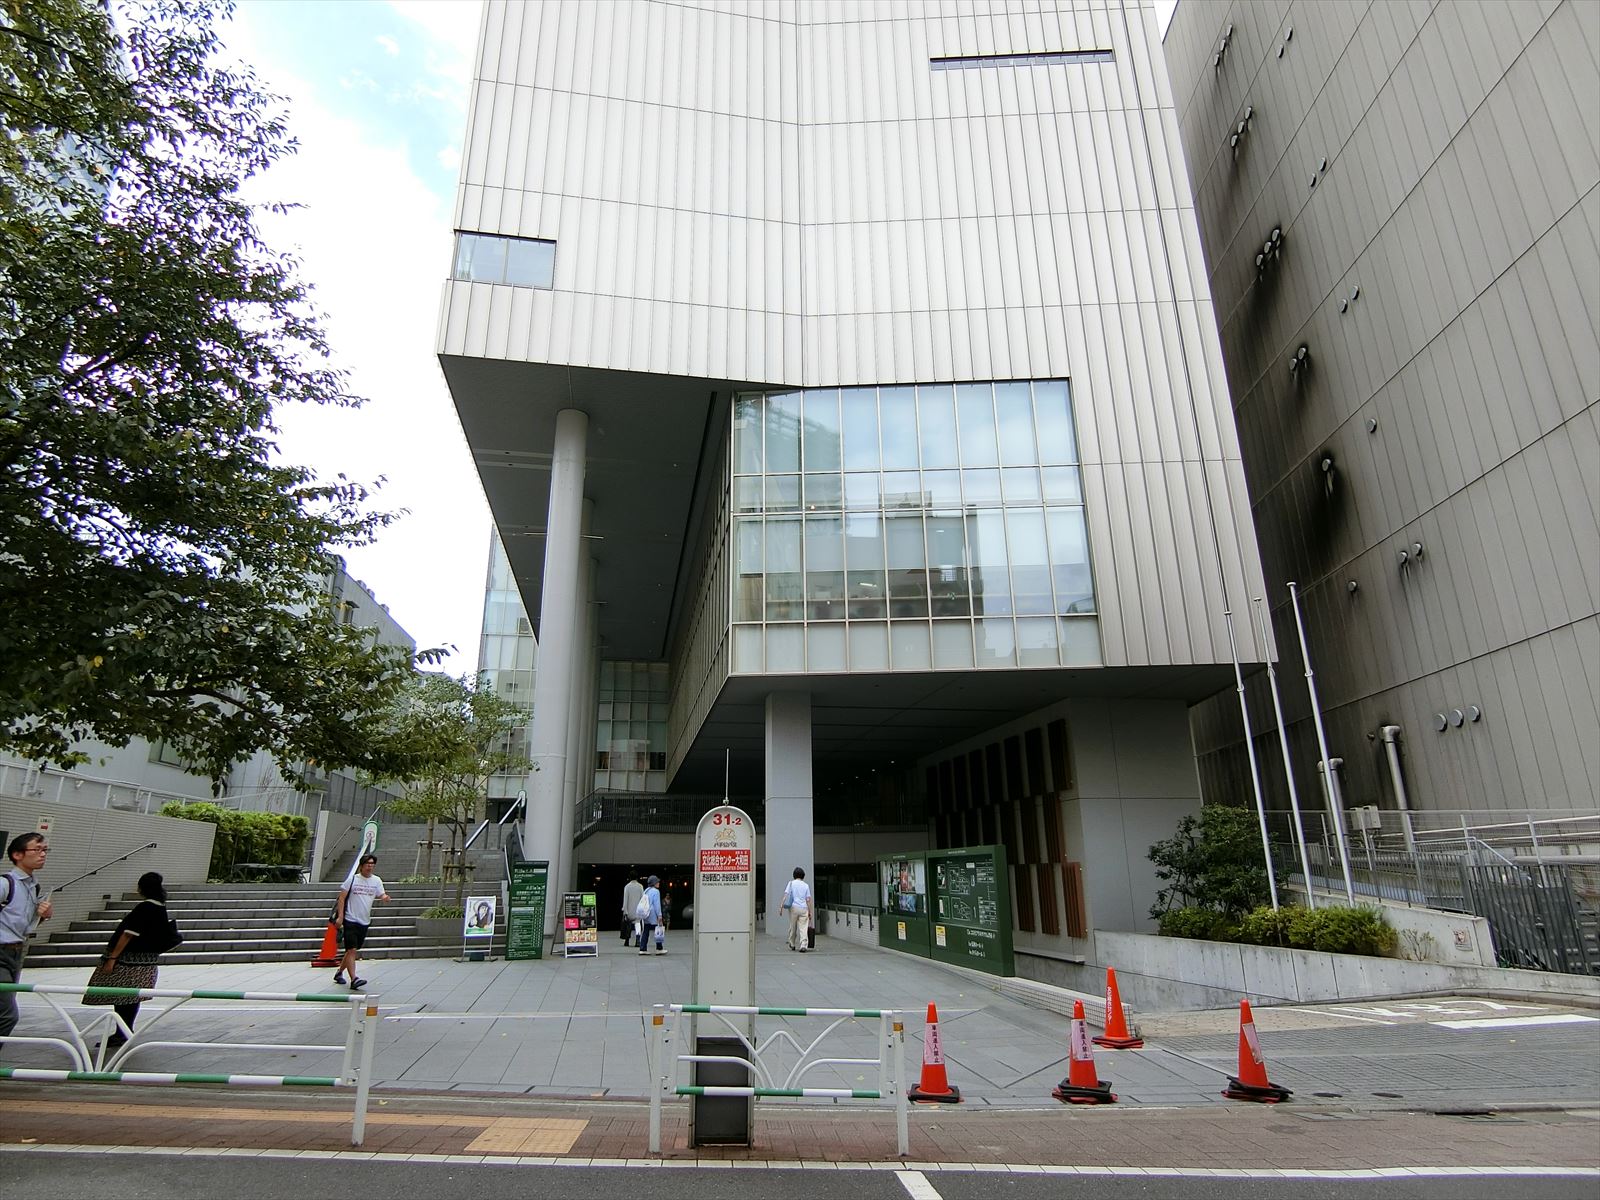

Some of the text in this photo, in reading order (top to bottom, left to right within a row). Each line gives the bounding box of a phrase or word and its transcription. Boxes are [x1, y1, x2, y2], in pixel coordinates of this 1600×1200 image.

[713, 813, 742, 825] 31-2
[702, 855, 748, 865] 文化総合センター大和田
